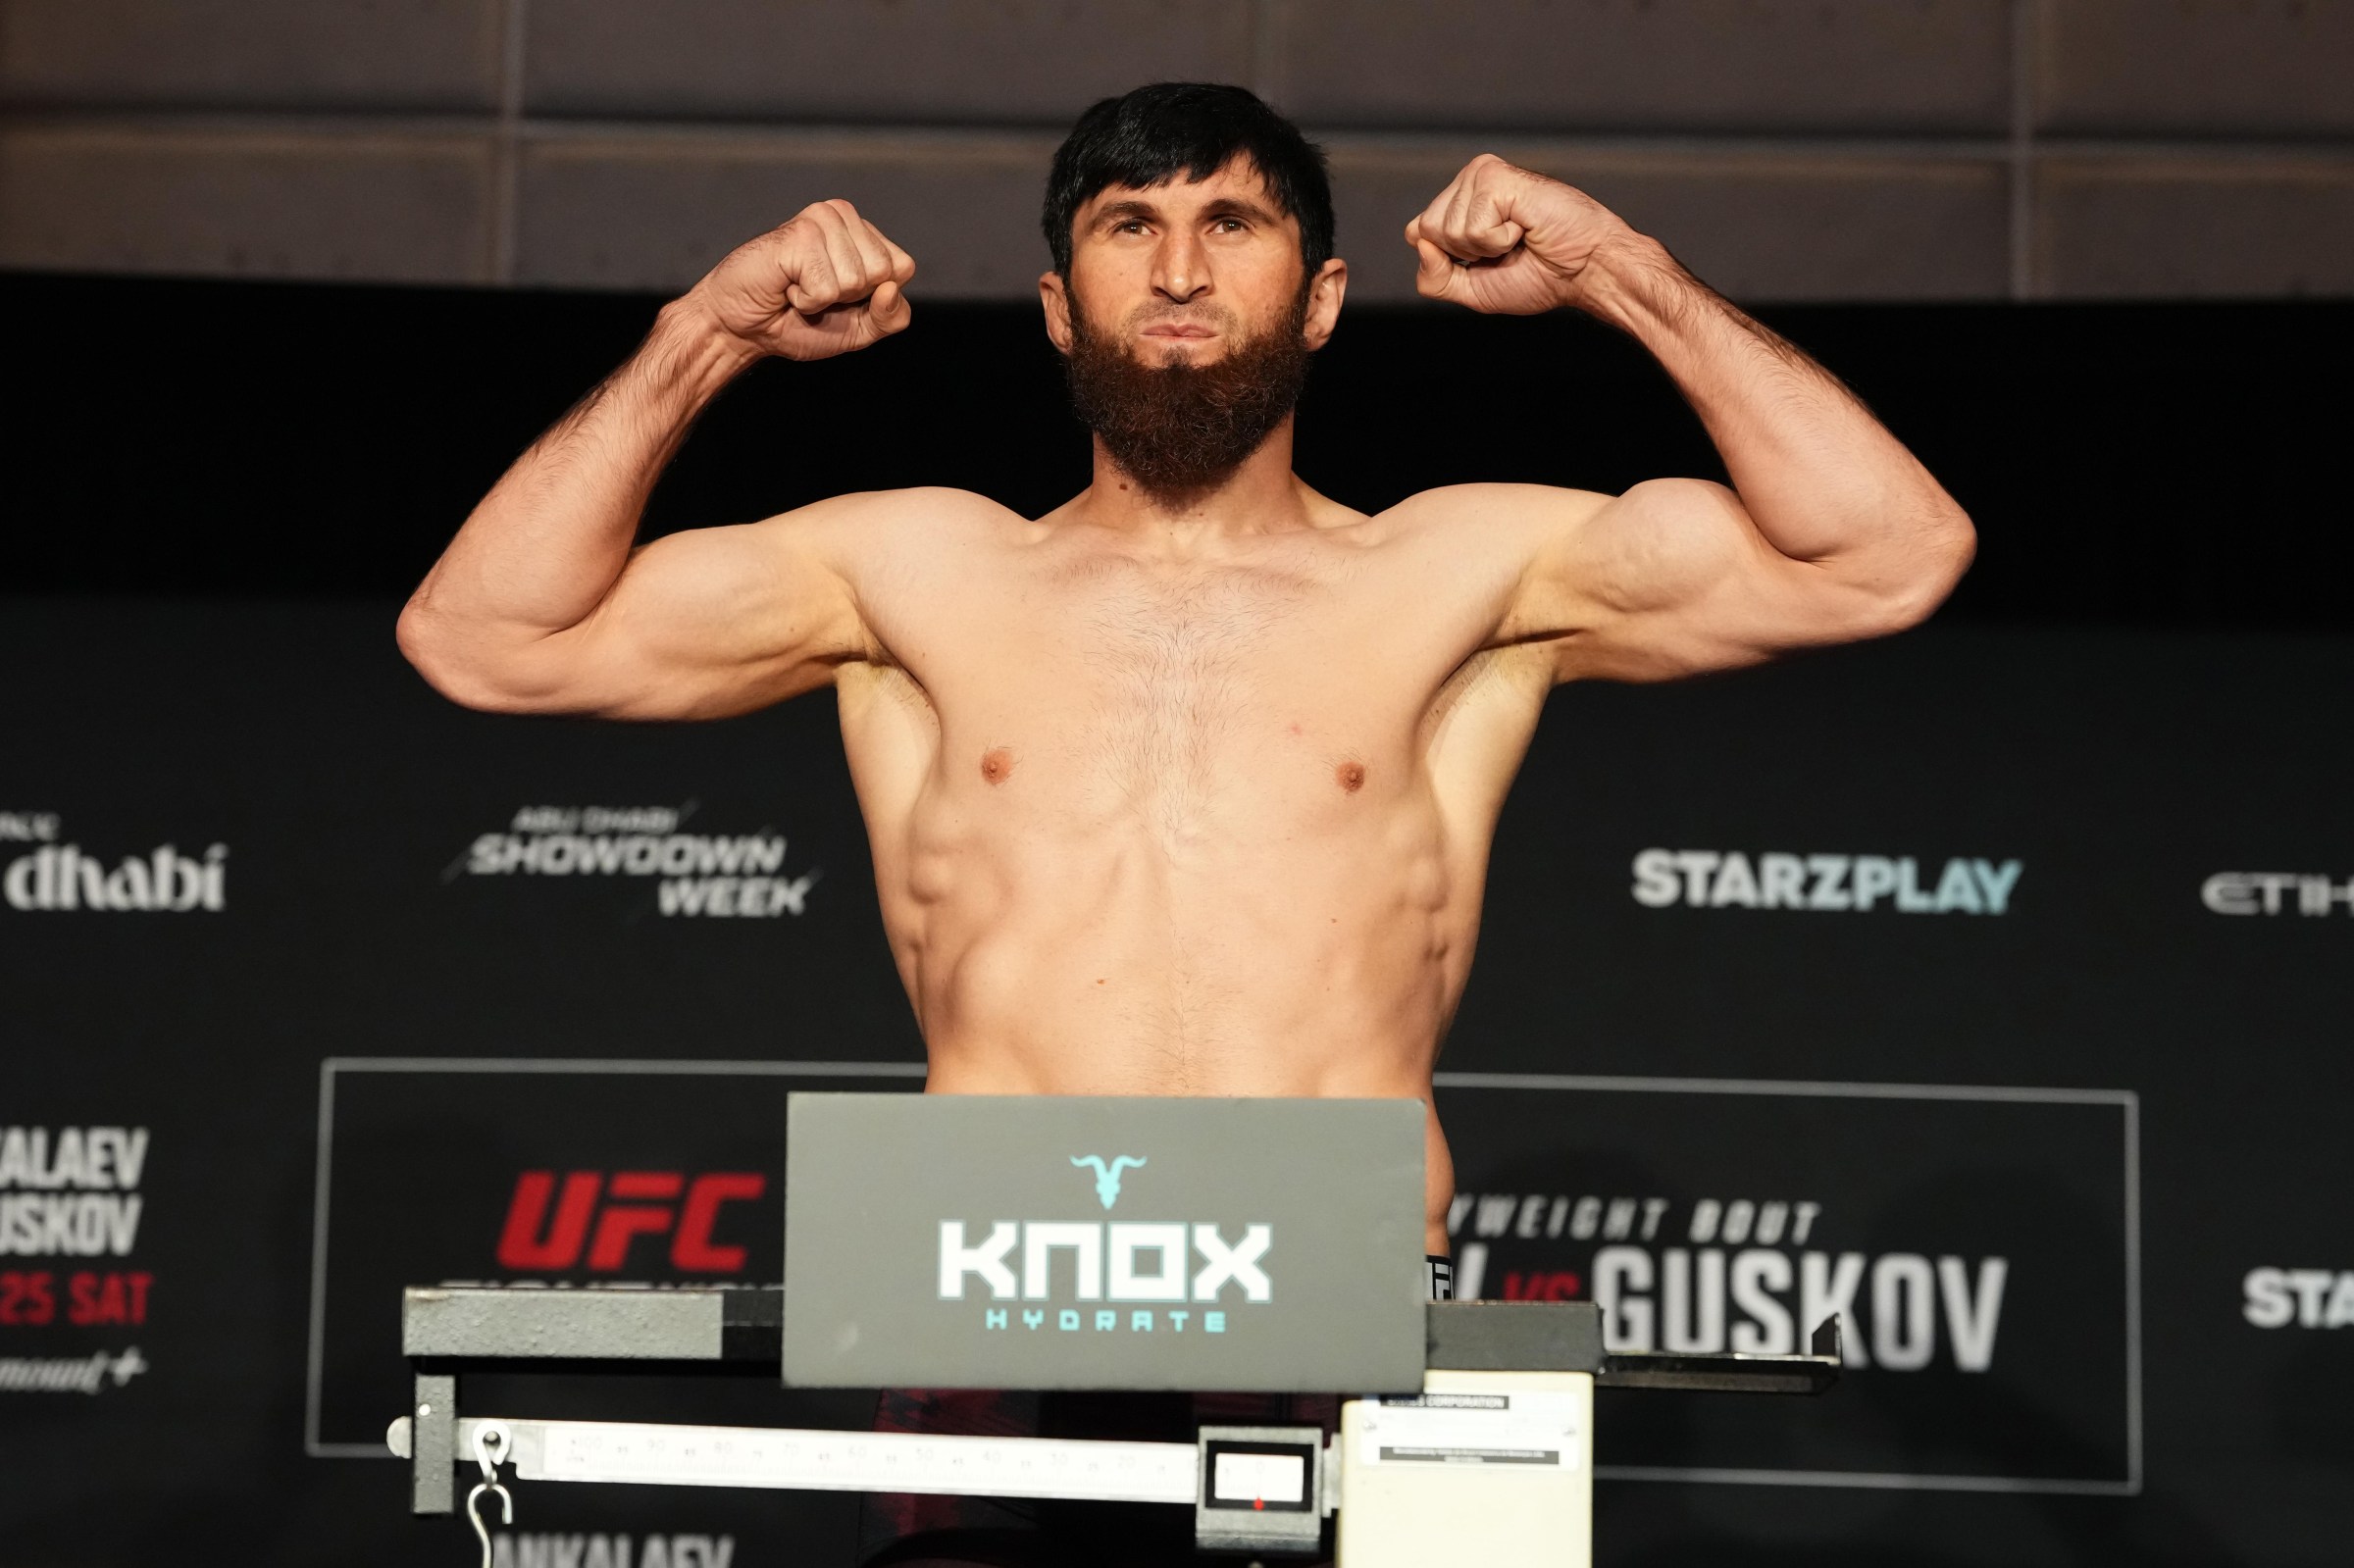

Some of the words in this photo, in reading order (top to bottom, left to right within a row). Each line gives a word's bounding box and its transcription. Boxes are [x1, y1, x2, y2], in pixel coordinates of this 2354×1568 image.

[4, 842, 229, 911] dhabi
[469, 834, 787, 876] SHOWDOWN
[1631, 847, 2022, 915] STARZPLAY
[658, 876, 808, 918] WEEK
[495, 1171, 767, 1272] UFC
[1688, 1197, 1822, 1246] BOUT
[938, 1219, 1273, 1303] KNOX
[69, 1271, 155, 1325] SAT
[986, 1308, 1226, 1333] HYDRATE
[1591, 1245, 2009, 1371] GUSKOV
